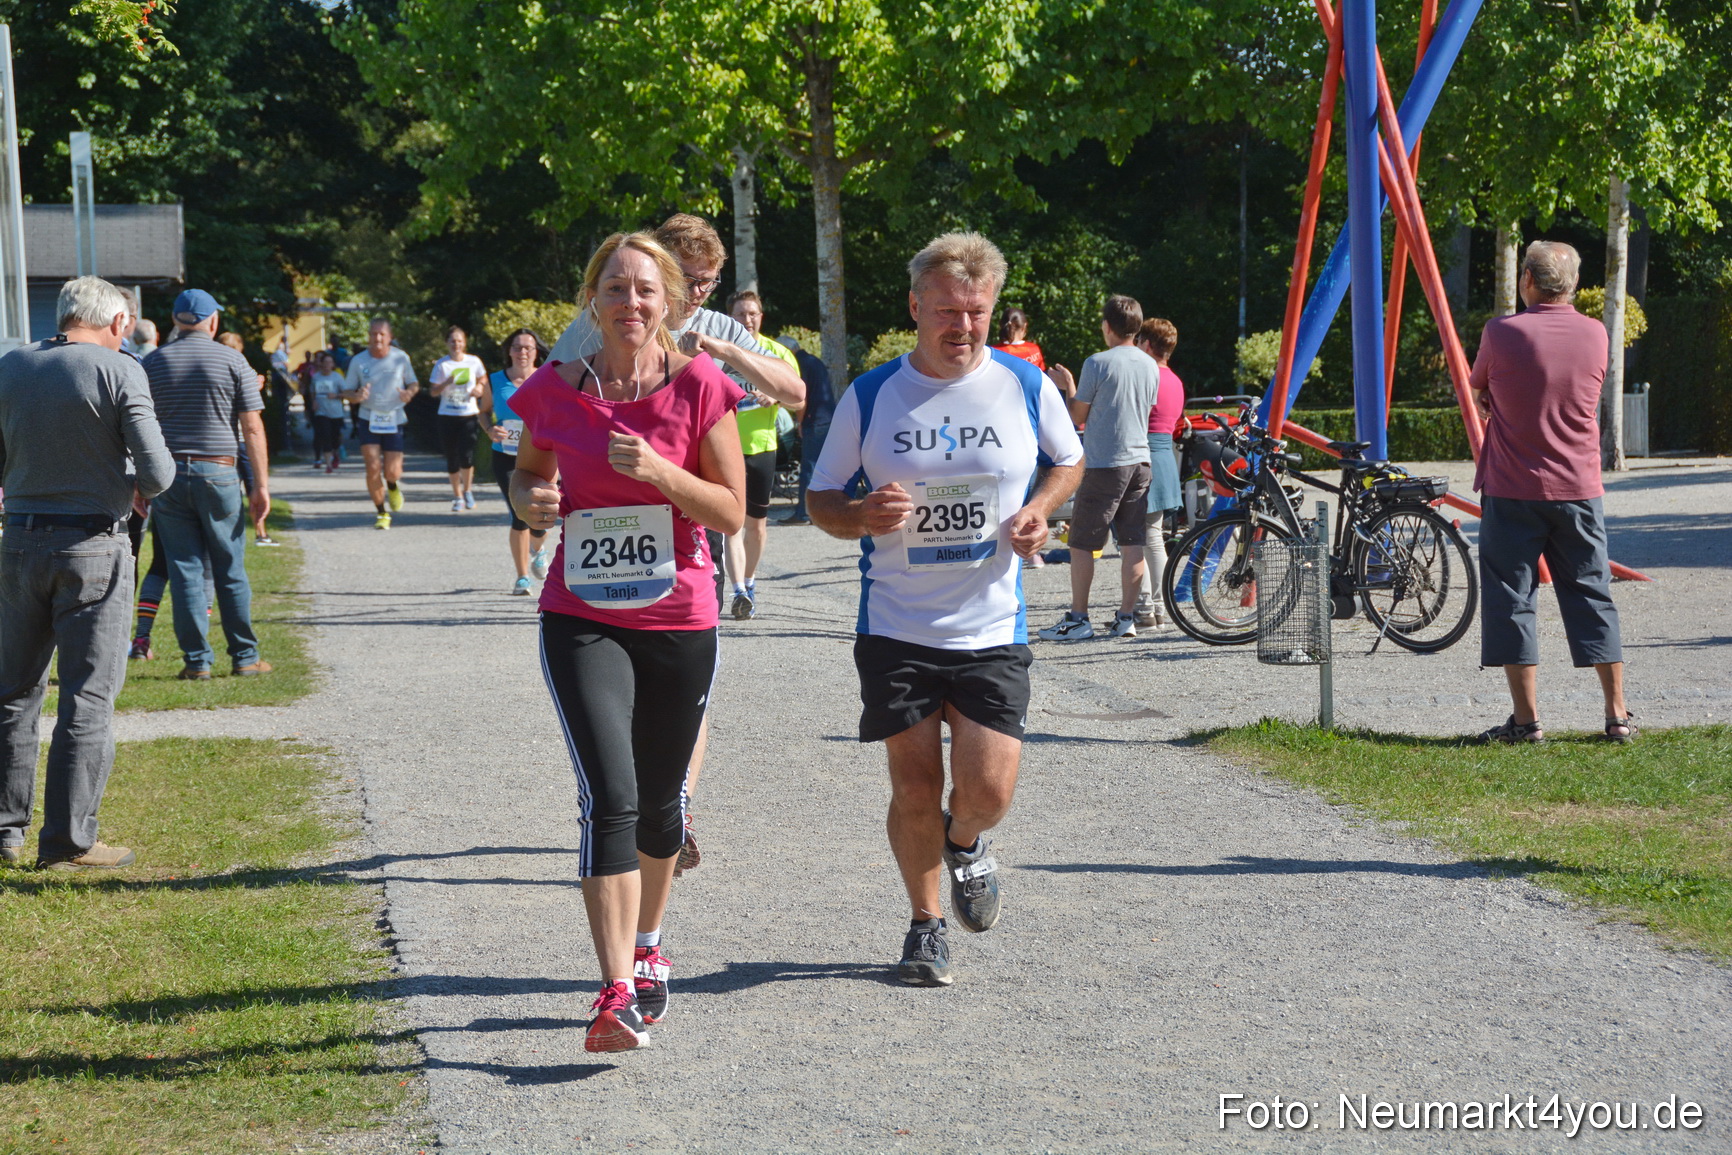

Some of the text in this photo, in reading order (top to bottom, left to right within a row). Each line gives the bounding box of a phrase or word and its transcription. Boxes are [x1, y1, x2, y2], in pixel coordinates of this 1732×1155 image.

[893, 425, 1003, 454] SUSPA
[927, 485, 970, 497] BOCK
[594, 516, 640, 529] BOCK
[915, 502, 986, 533] 2395
[923, 534, 974, 543] PARTL Neumarkt
[580, 534, 657, 569] 2346
[936, 547, 972, 561] Albert
[611, 570, 644, 579] Neumarkt
[604, 585, 638, 600] Tanja
